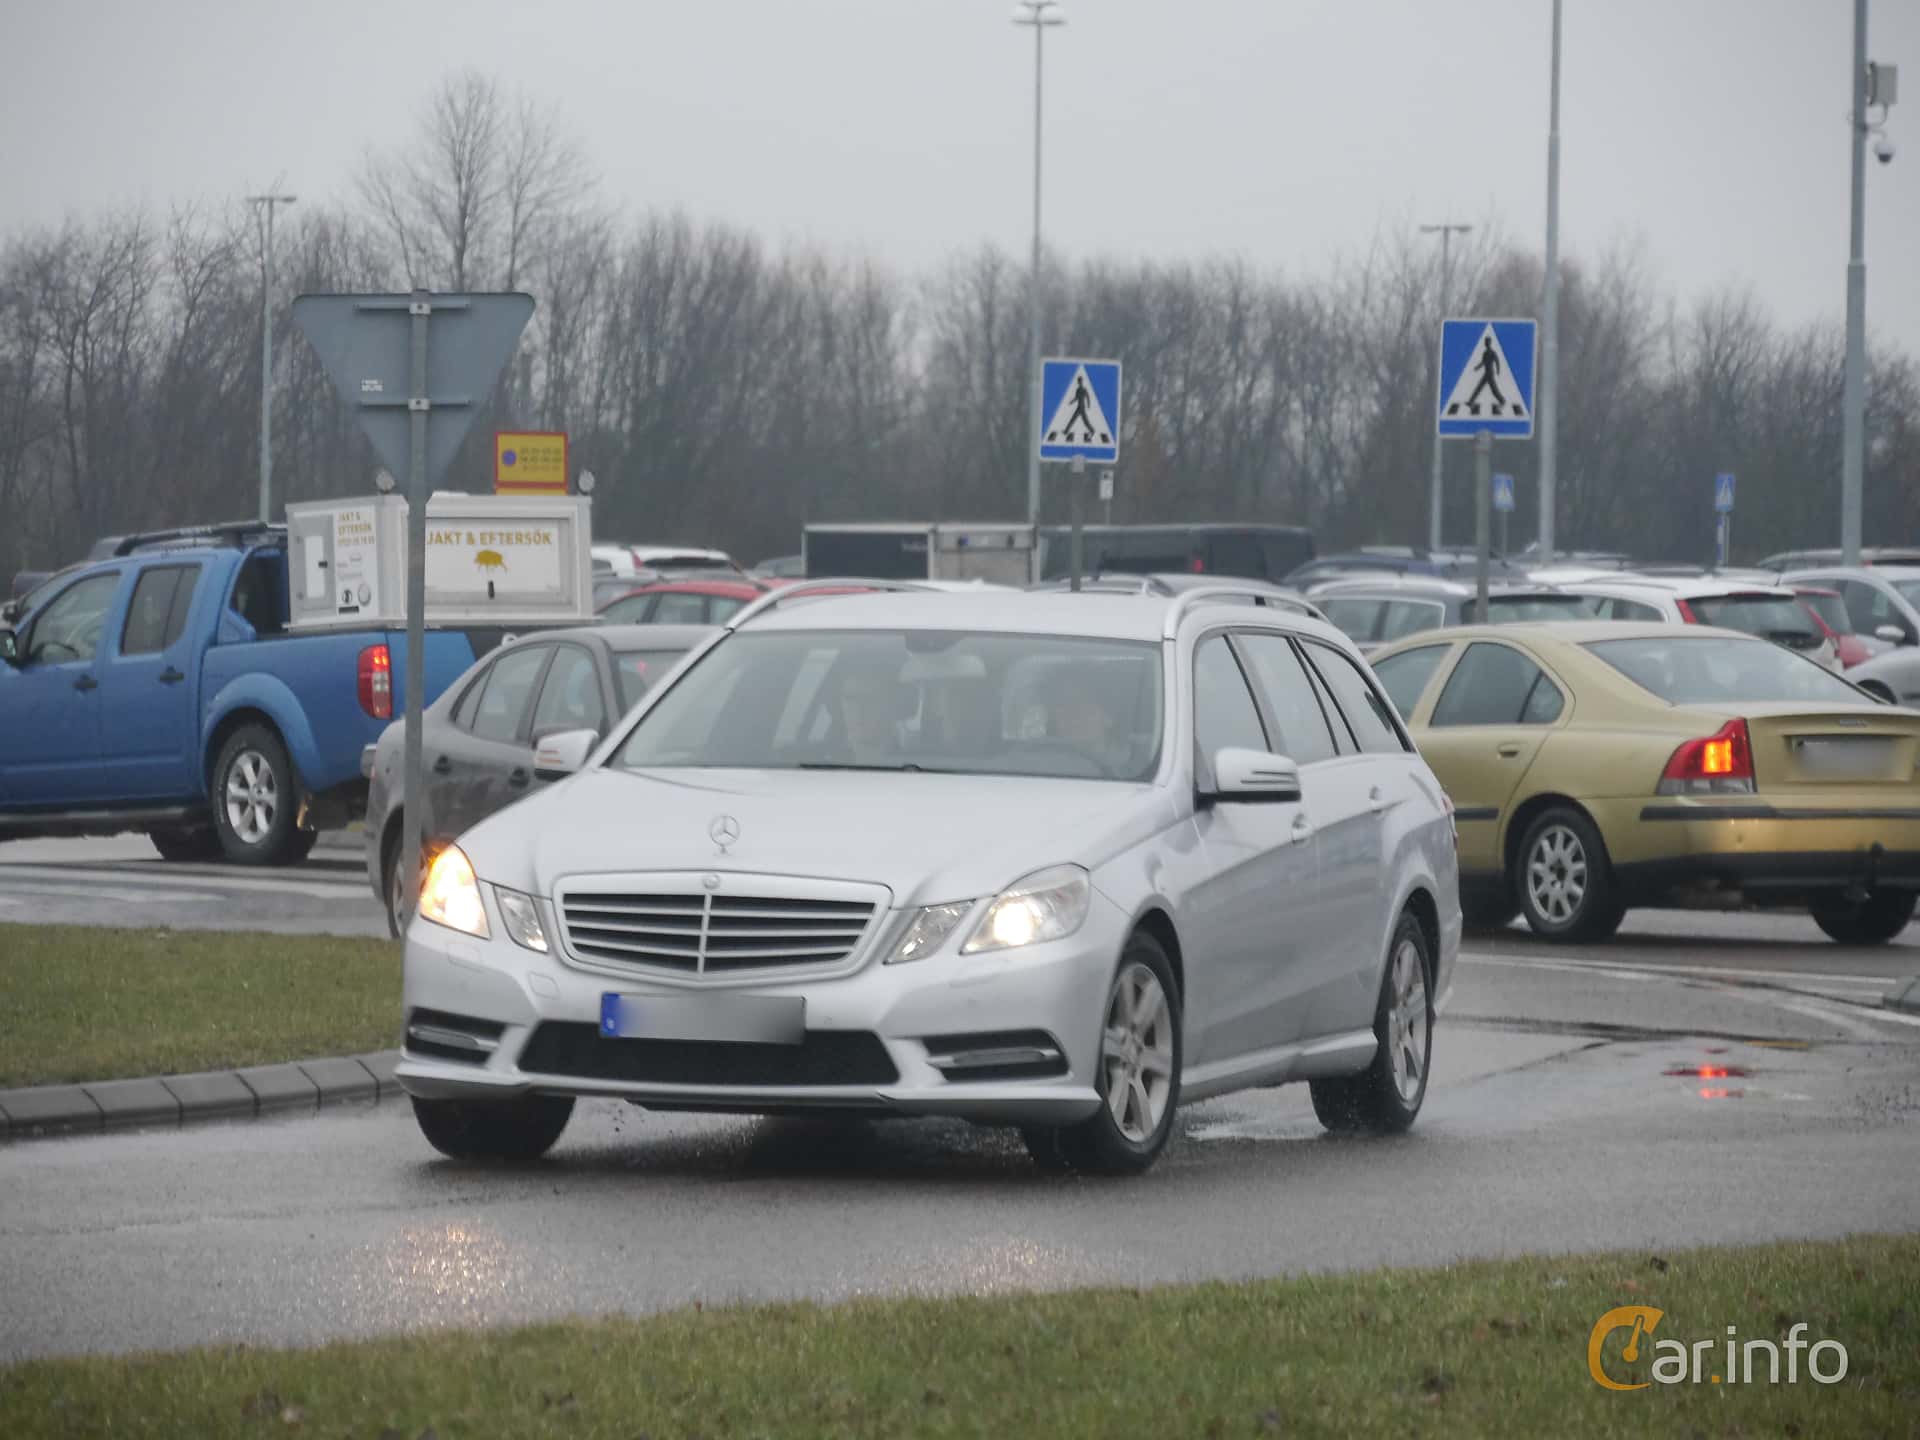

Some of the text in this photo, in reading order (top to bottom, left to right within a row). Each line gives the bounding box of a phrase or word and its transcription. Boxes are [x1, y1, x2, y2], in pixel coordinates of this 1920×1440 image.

[427, 528, 552, 545] JAKT & EFTERSÖK
